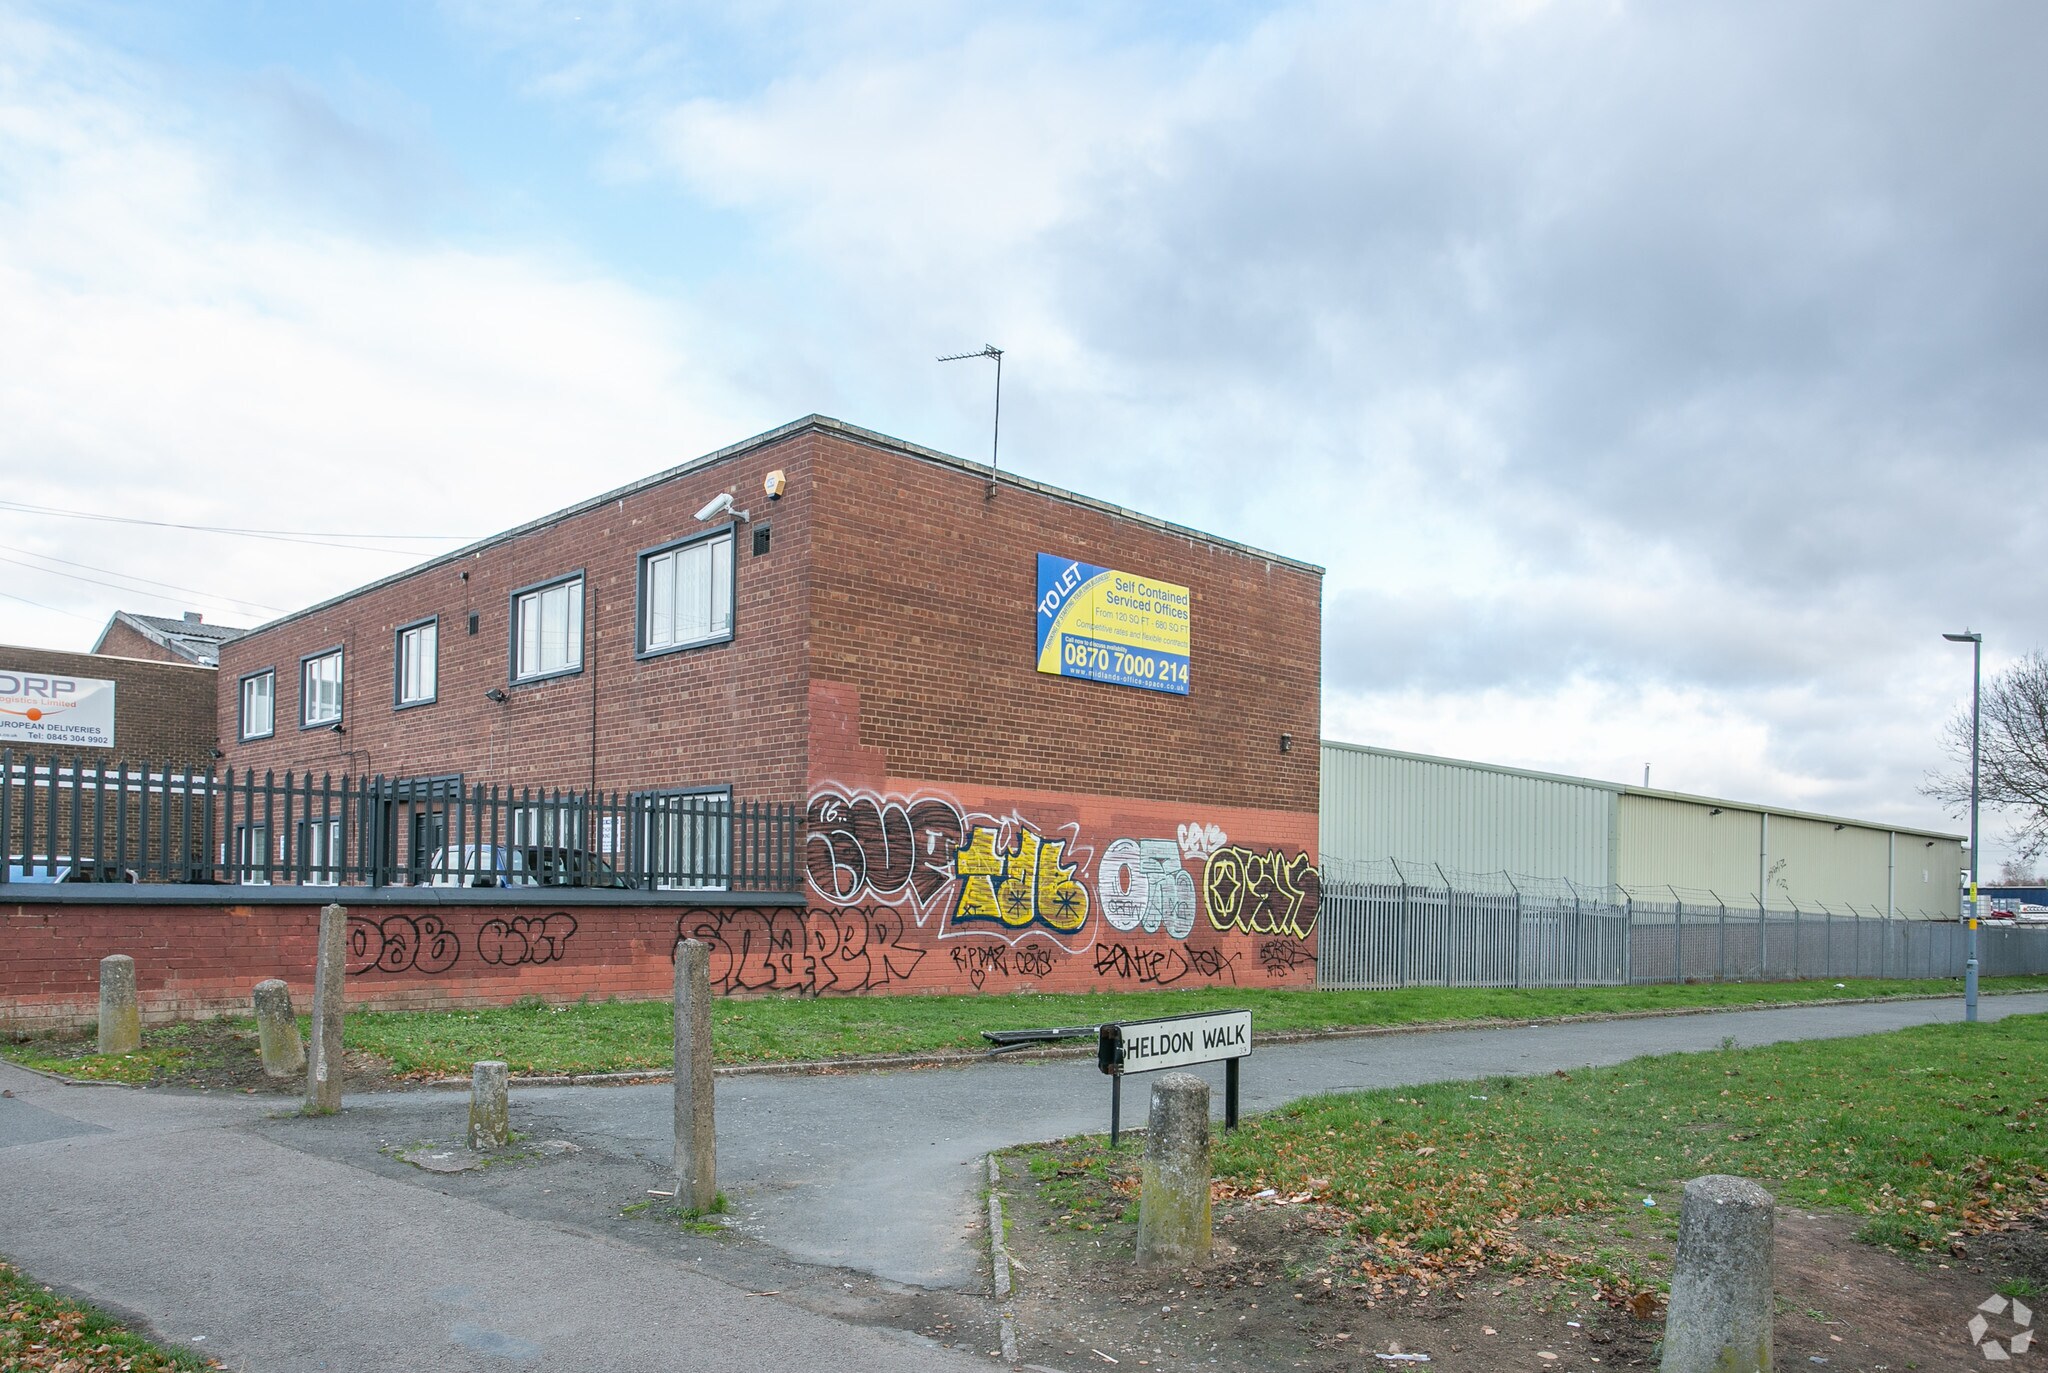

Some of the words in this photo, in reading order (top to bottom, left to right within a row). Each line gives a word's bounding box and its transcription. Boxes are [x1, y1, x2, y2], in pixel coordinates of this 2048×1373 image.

[1038, 590, 1060, 618] TO
[1055, 562, 1082, 597] LET
[1115, 578, 1135, 593] Self
[1138, 583, 1187, 605] Contained
[1060, 599, 1074, 620] STARTING
[1106, 591, 1151, 612] Serviced
[1154, 602, 1188, 620] Offices
[1076, 618, 1113, 634] Competitive
[1114, 627, 1128, 637] rates
[1130, 631, 1141, 639] and
[1142, 632, 1162, 642] flexible
[1163, 637, 1189, 648] contracts
[1095, 607, 1114, 619] From
[1115, 612, 1127, 622] 120
[1129, 614, 1139, 625] SQ
[1141, 616, 1149, 625] FT
[1155, 620, 1167, 630] 680
[1169, 623, 1179, 633] SQ
[1180, 624, 1189, 634] FT
[1065, 643, 1109, 671] 0870
[1114, 652, 1155, 678] 7000
[1159, 660, 1189, 684] 214
[1070, 668, 1185, 692] www.midlands-office-space.co.uk
[41, 699, 77, 708] Limited
[28, 731, 44, 739] Tel:
[46, 733, 67, 741] 0845
[88, 736, 108, 744] 9902
[47, 724, 101, 734] DELIVERIES
[1203, 1024, 1246, 1050] WALK
